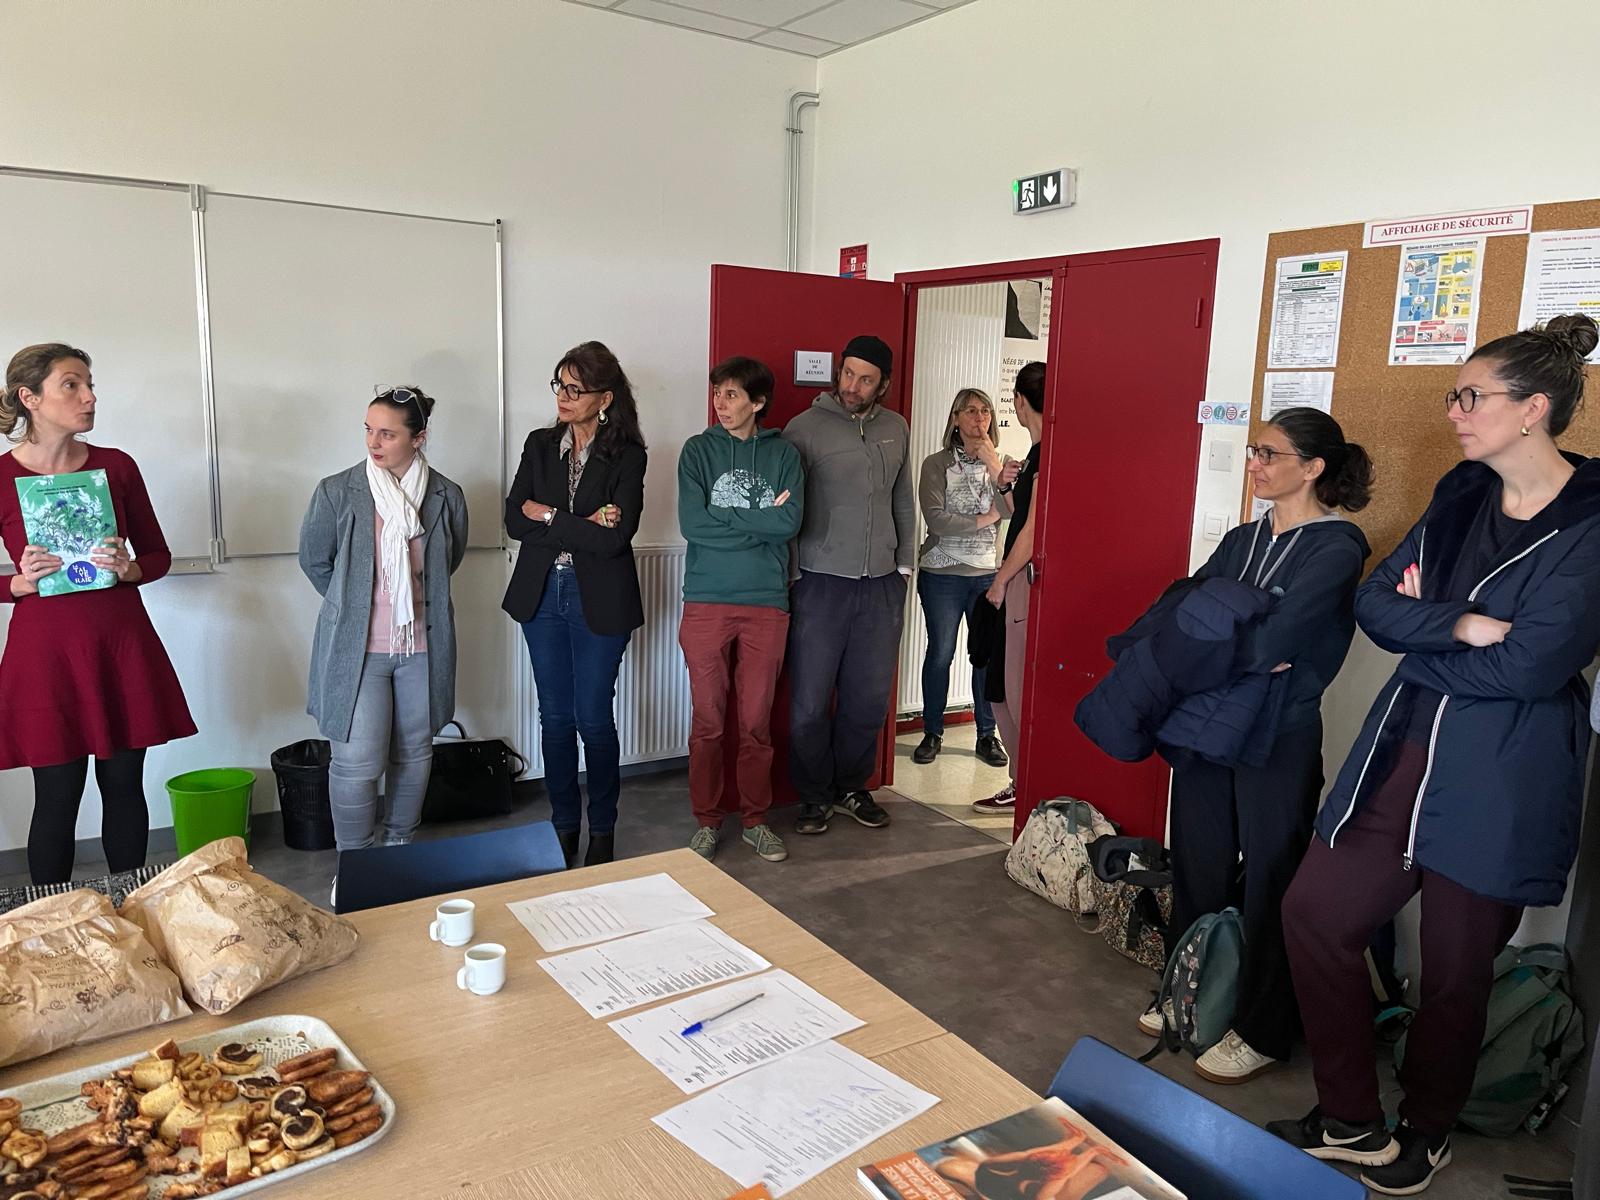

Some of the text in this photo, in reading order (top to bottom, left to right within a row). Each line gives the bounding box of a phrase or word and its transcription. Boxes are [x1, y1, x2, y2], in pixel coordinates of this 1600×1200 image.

[1381, 214, 1514, 237] AFFICHAGE DE SÉCURITÉ
